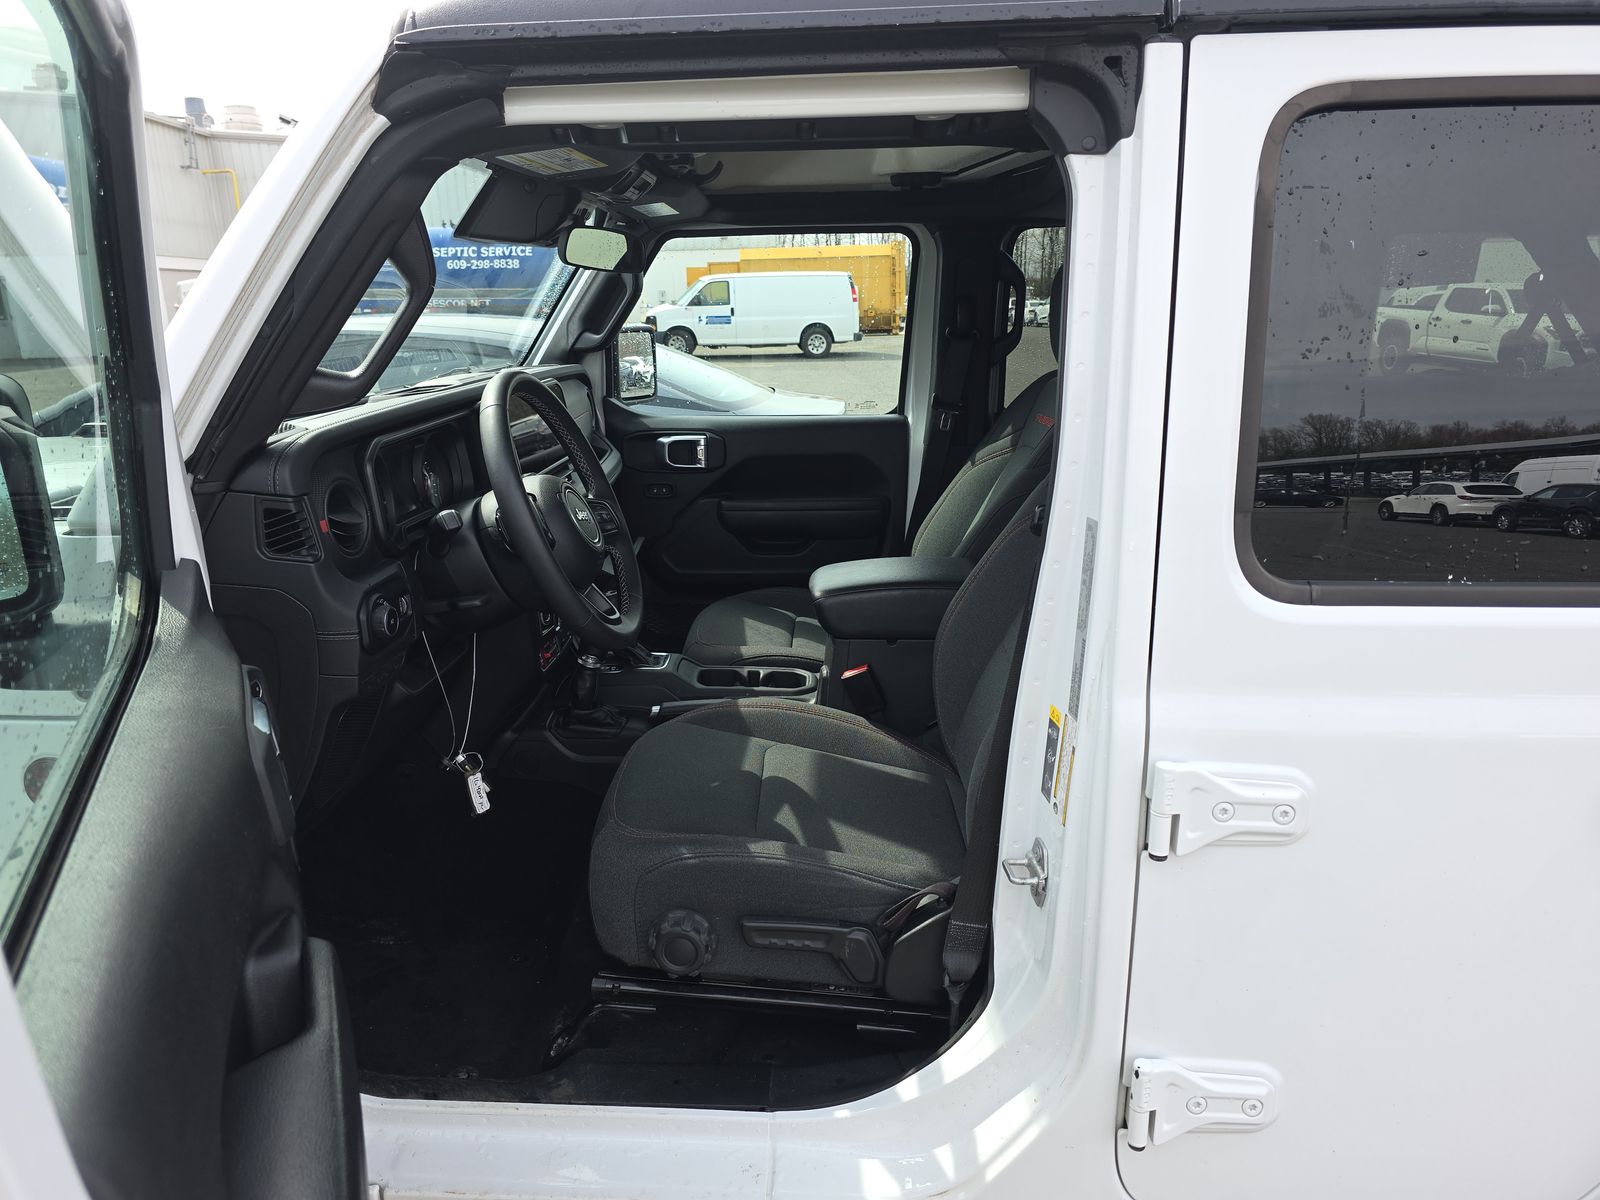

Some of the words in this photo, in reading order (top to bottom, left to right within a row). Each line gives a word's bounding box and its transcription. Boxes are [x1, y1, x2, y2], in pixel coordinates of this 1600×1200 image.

[433, 246, 477, 257] SEPTIC
[480, 245, 533, 257] SERVICE
[446, 259, 520, 270] 609-298-8838
[575, 508, 589, 521] Jeep
